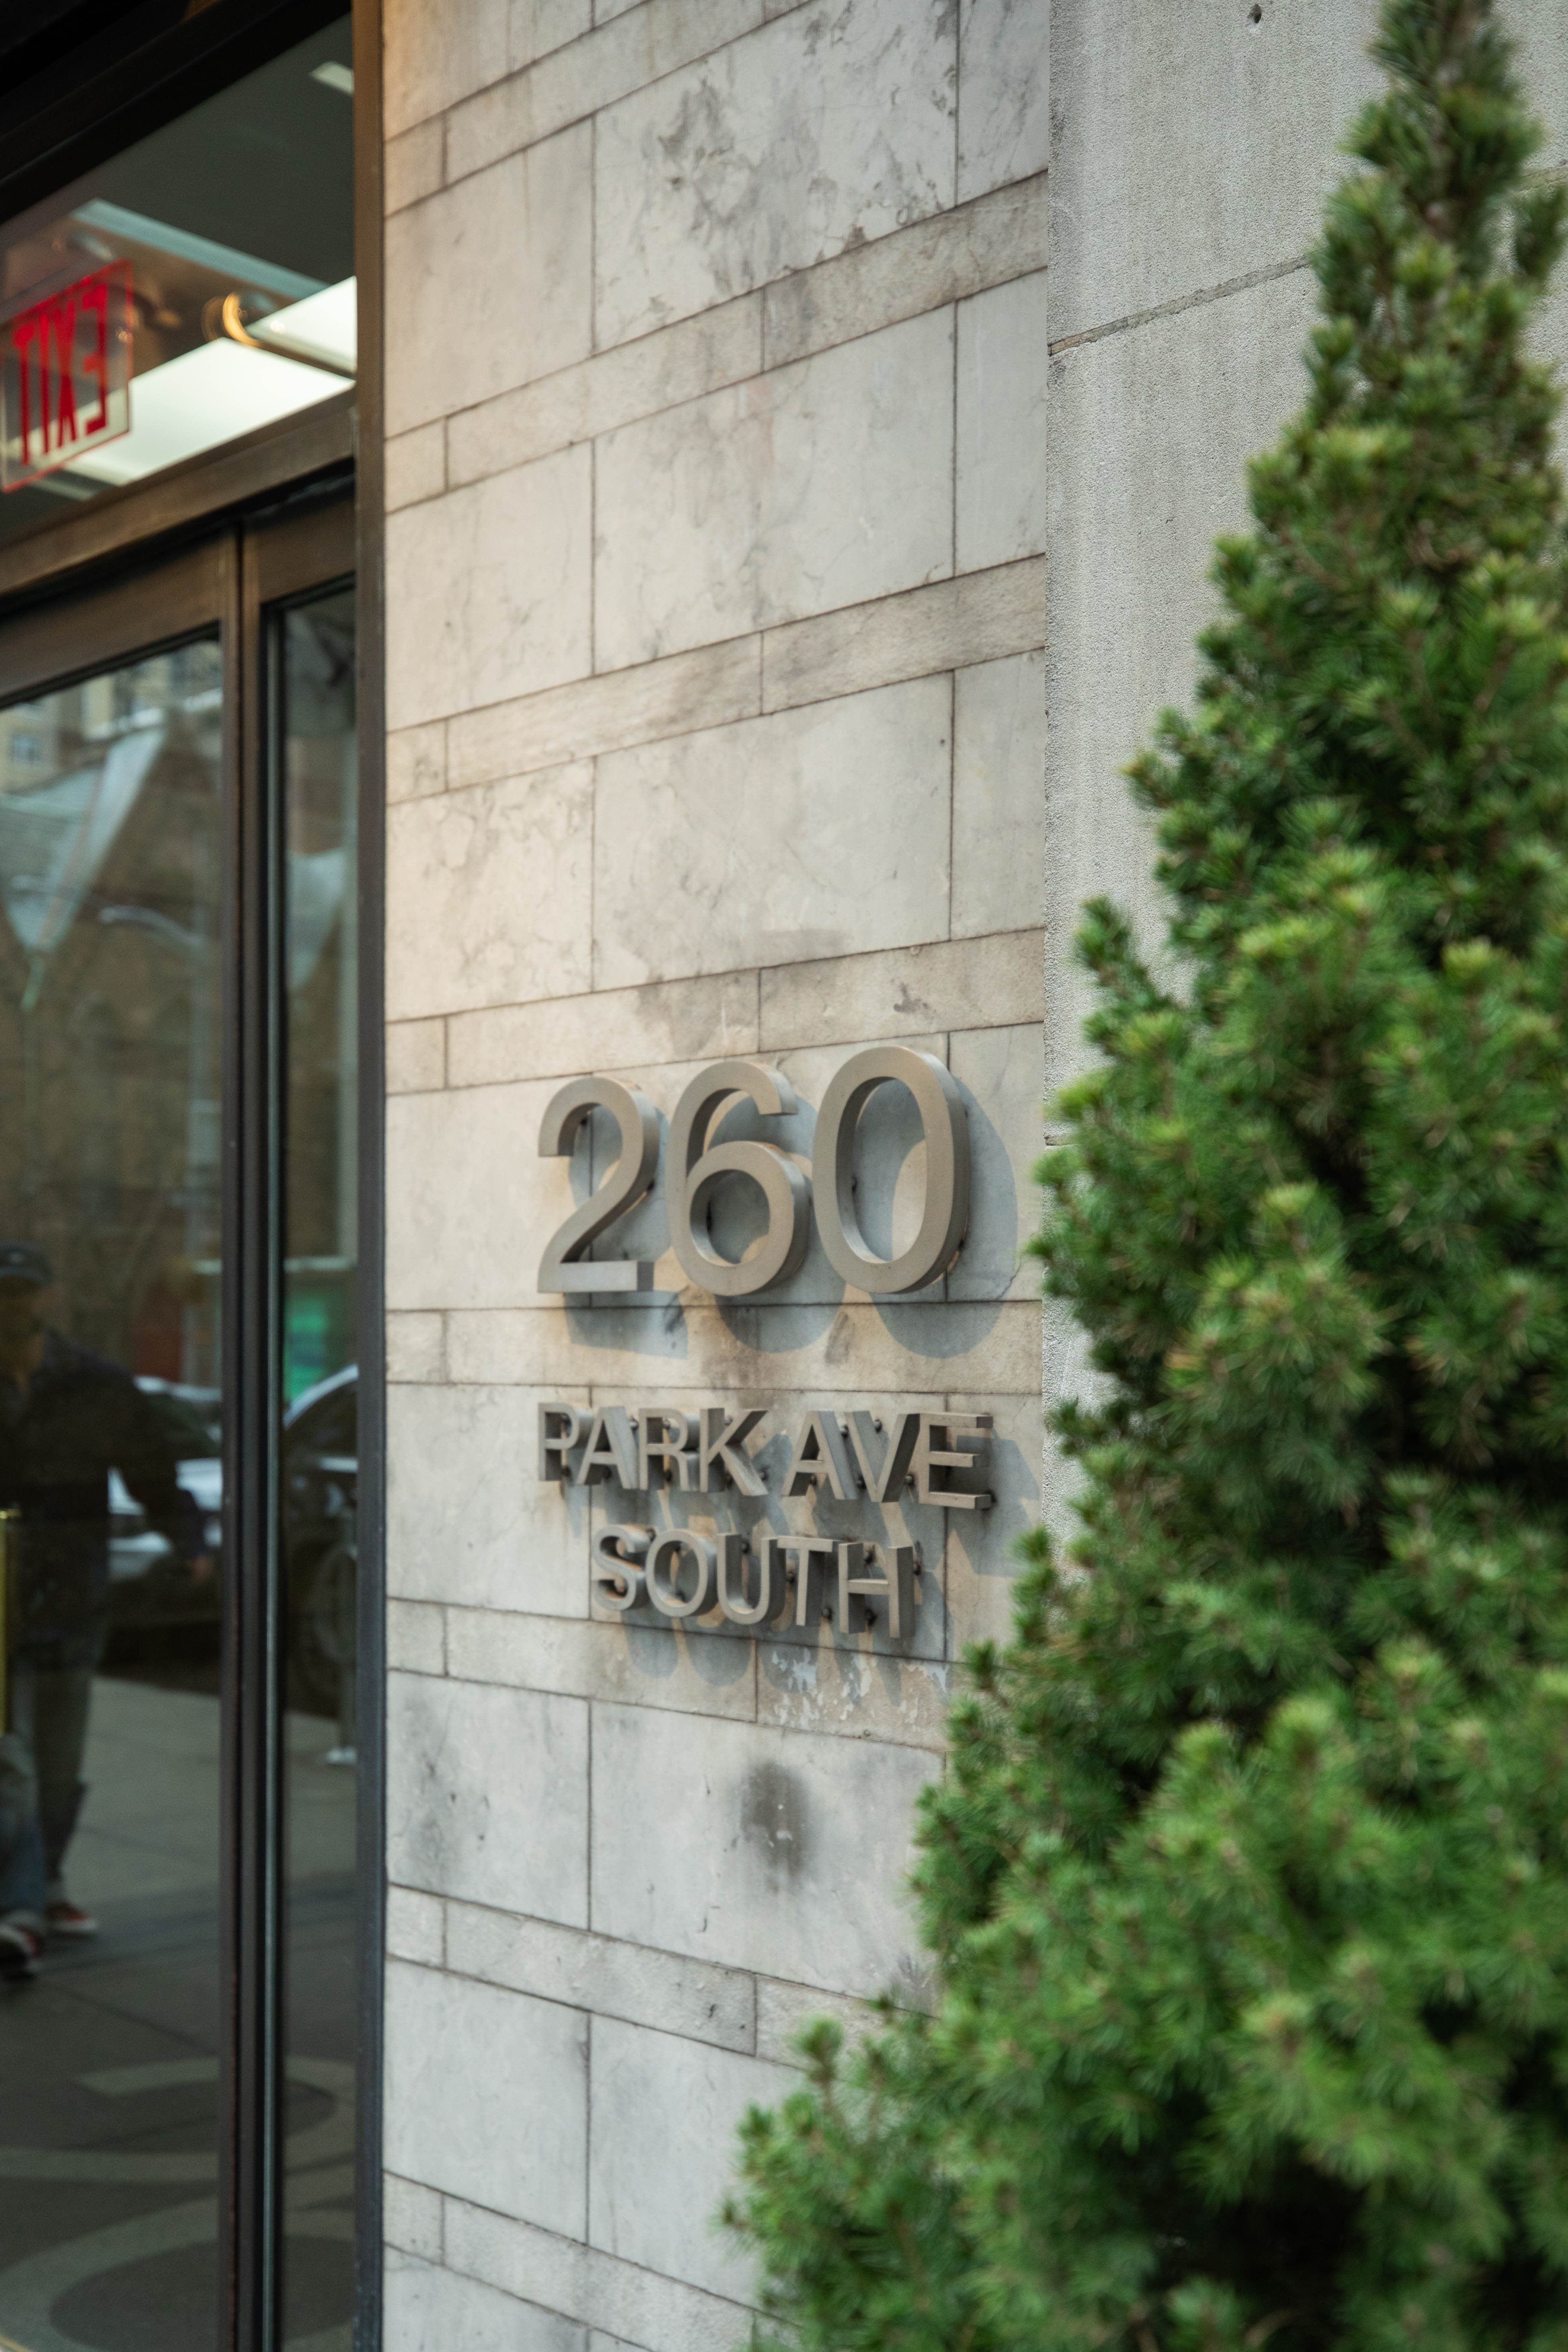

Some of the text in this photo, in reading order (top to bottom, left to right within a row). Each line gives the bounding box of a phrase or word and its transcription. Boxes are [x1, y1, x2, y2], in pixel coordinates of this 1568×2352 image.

[538, 1046, 971, 1296] 260
[538, 1402, 993, 1509] PARK AVE
[591, 1524, 915, 1638] SOUTH
